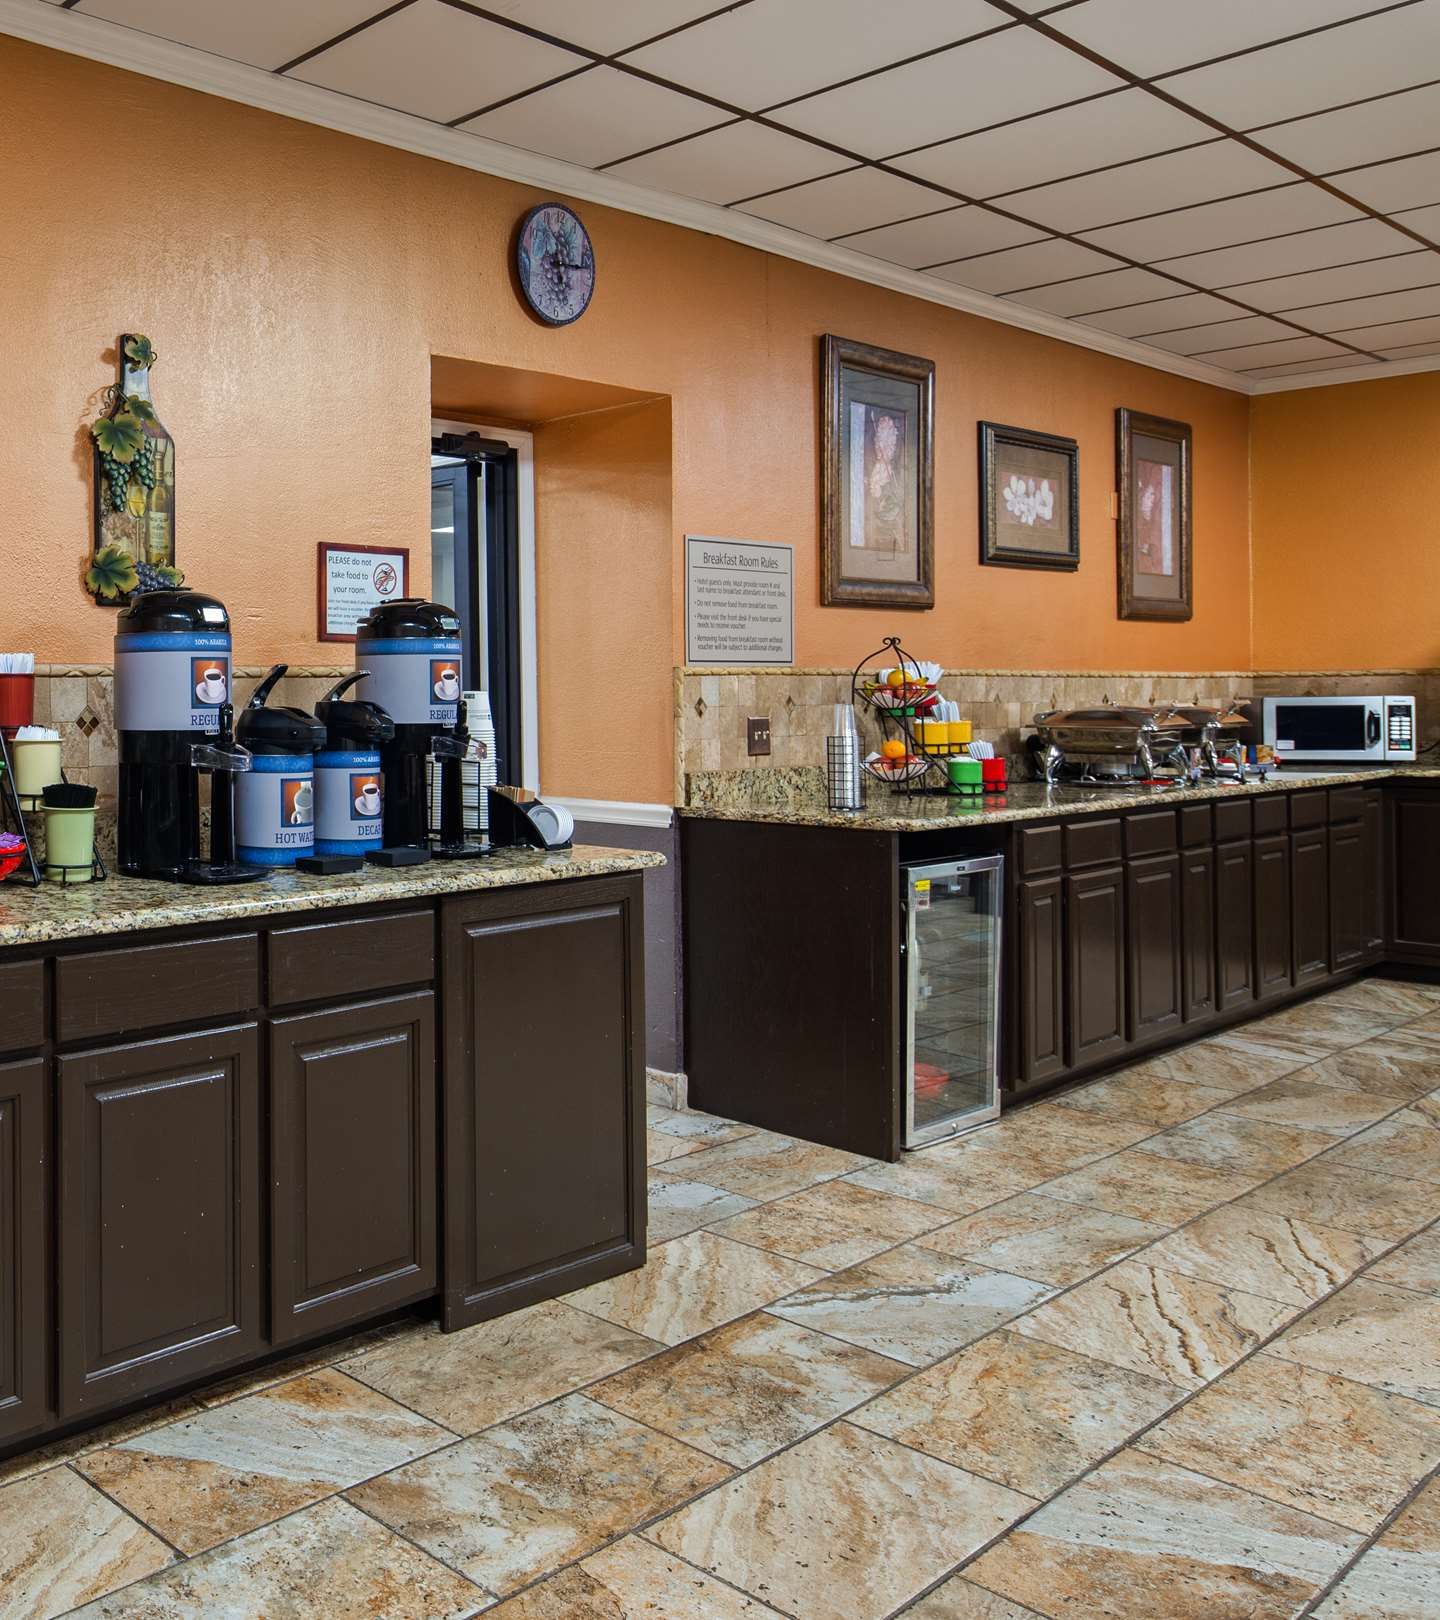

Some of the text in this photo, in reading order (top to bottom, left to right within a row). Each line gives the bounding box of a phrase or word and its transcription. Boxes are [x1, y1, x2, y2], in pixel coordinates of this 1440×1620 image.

[328, 556, 350, 565] PLEASE
[703, 552, 779, 569] Breakfast Room Rules
[331, 571, 345, 579] take
[346, 571, 361, 580] food
[191, 714, 219, 725] REGU
[430, 710, 457, 720] REGUL
[275, 832, 296, 843] HOT
